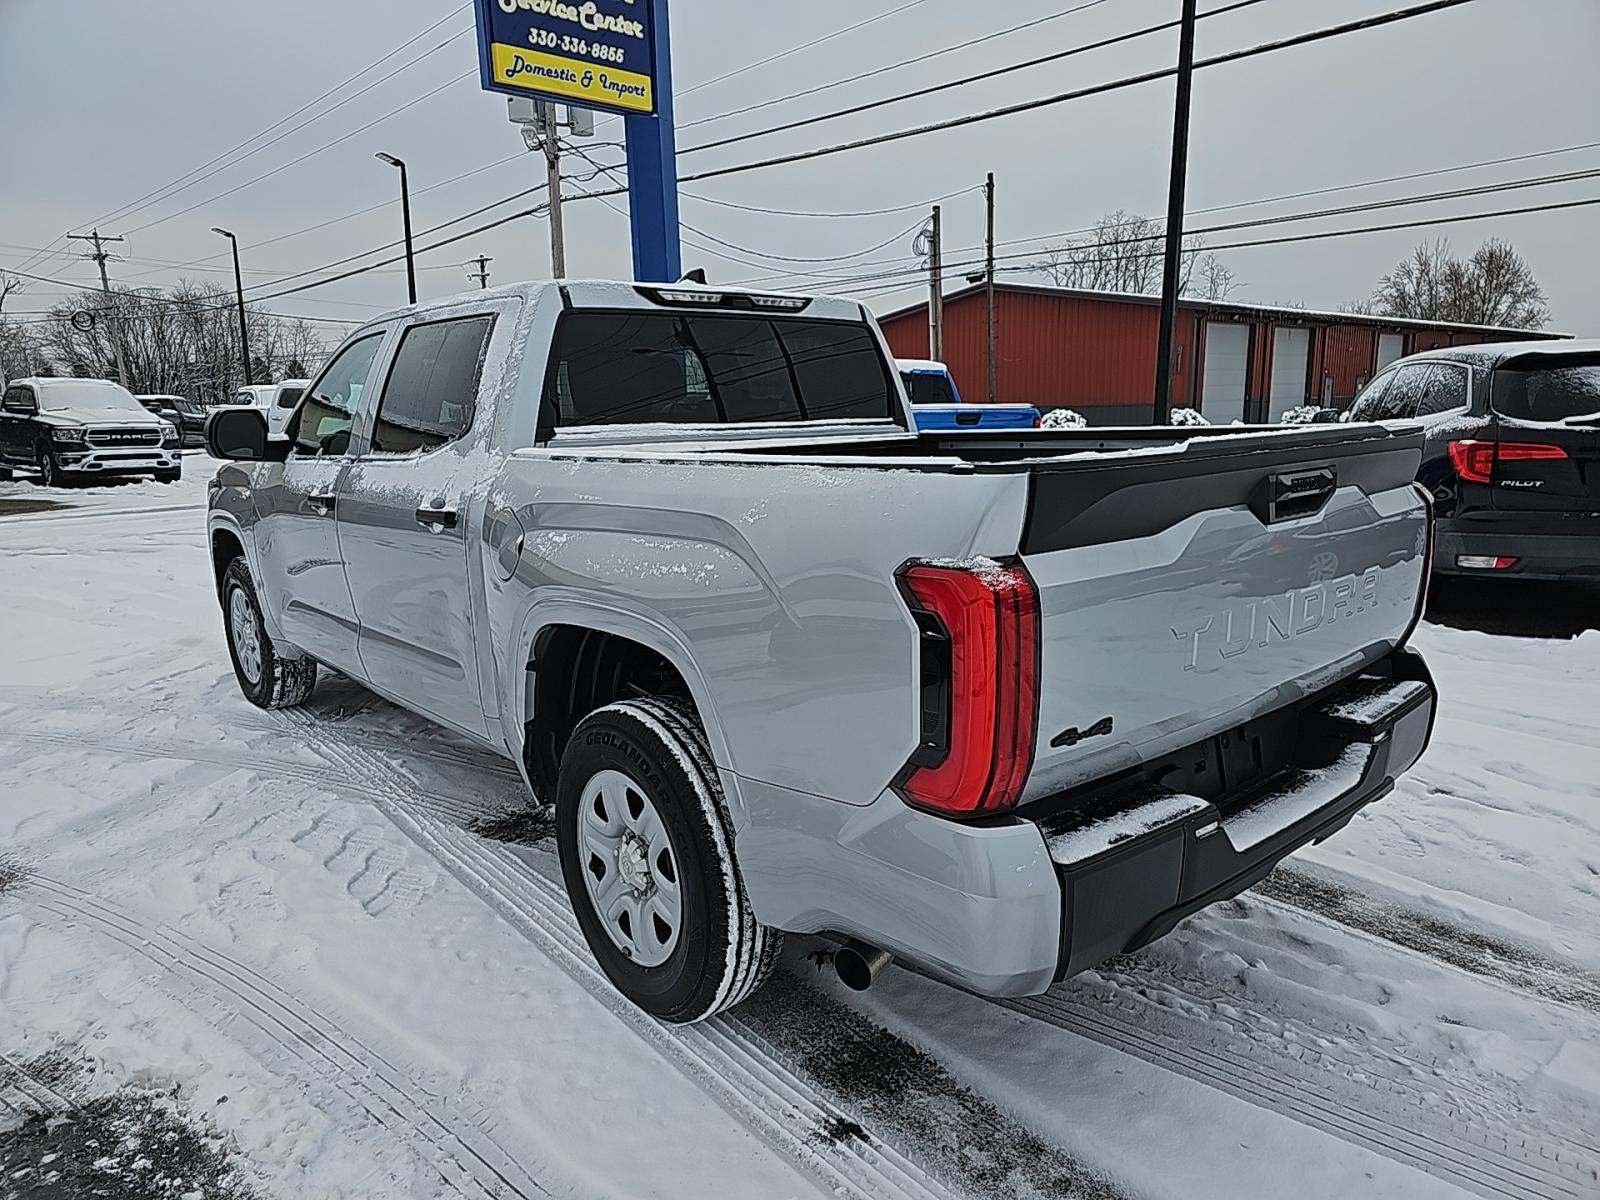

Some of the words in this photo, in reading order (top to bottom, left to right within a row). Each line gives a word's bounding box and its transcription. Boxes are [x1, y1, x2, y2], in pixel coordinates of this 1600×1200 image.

[578, 1, 644, 38] Center
[505, 54, 577, 82] Domestic
[580, 70, 593, 88] &
[599, 73, 646, 98] Import
[1500, 480, 1545, 488] PILOT
[1169, 565, 1381, 672] TUNDRA
